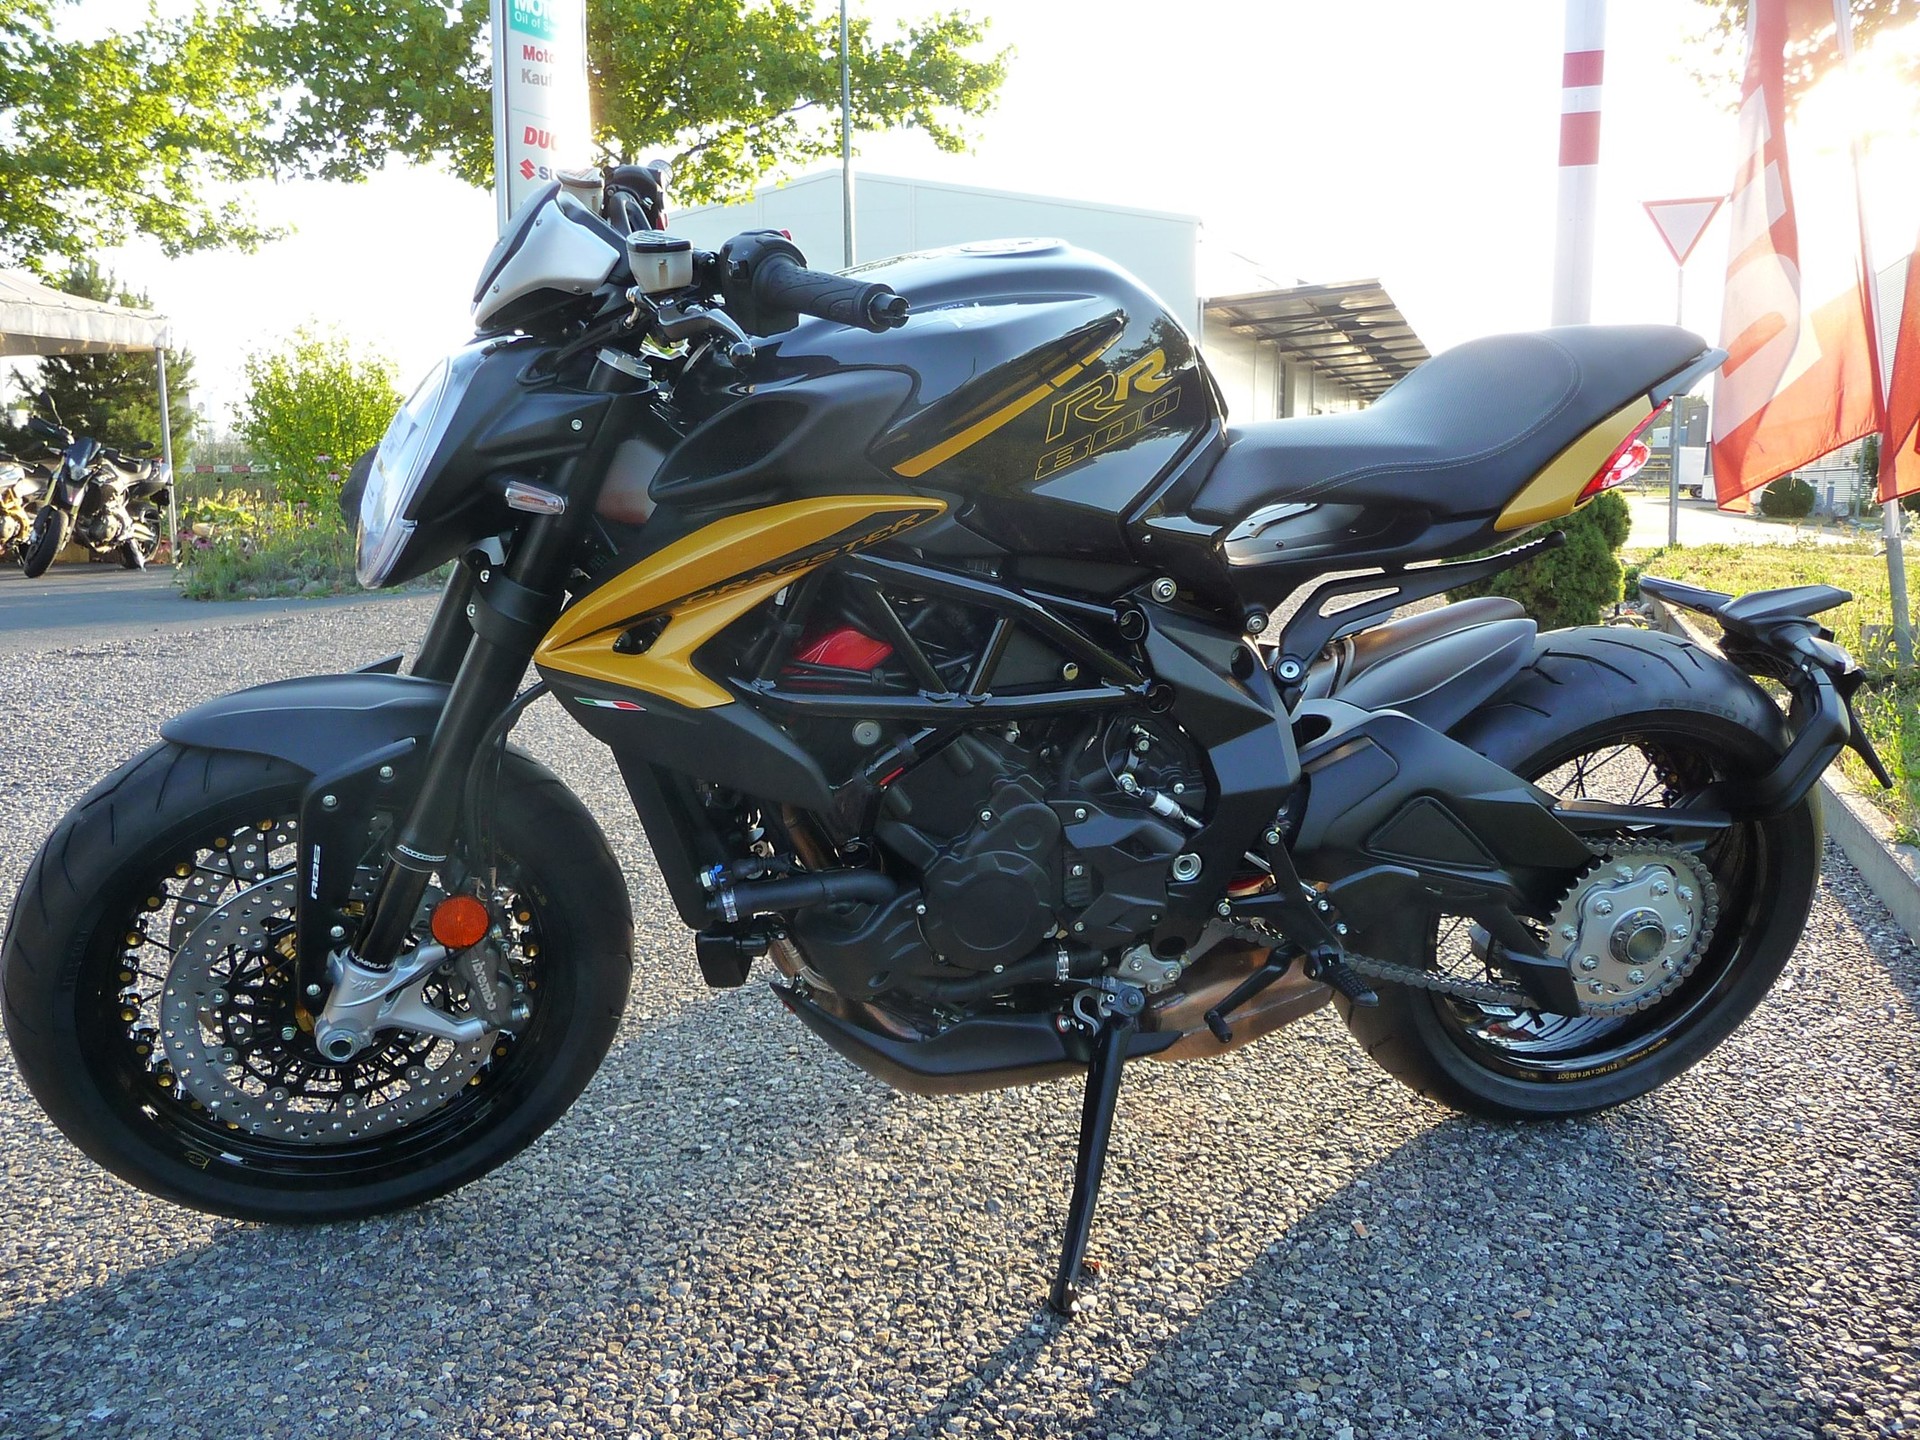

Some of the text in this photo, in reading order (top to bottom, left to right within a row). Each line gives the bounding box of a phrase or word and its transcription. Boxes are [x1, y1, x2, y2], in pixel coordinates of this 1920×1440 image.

[514, 11, 528, 25] Oil
[531, 18, 541, 29] of
[1035, 386, 1181, 480] 800
[1045, 347, 1174, 444] RR
[682, 513, 920, 606] DRAGSTER
[472, 961, 496, 1010] brembo
